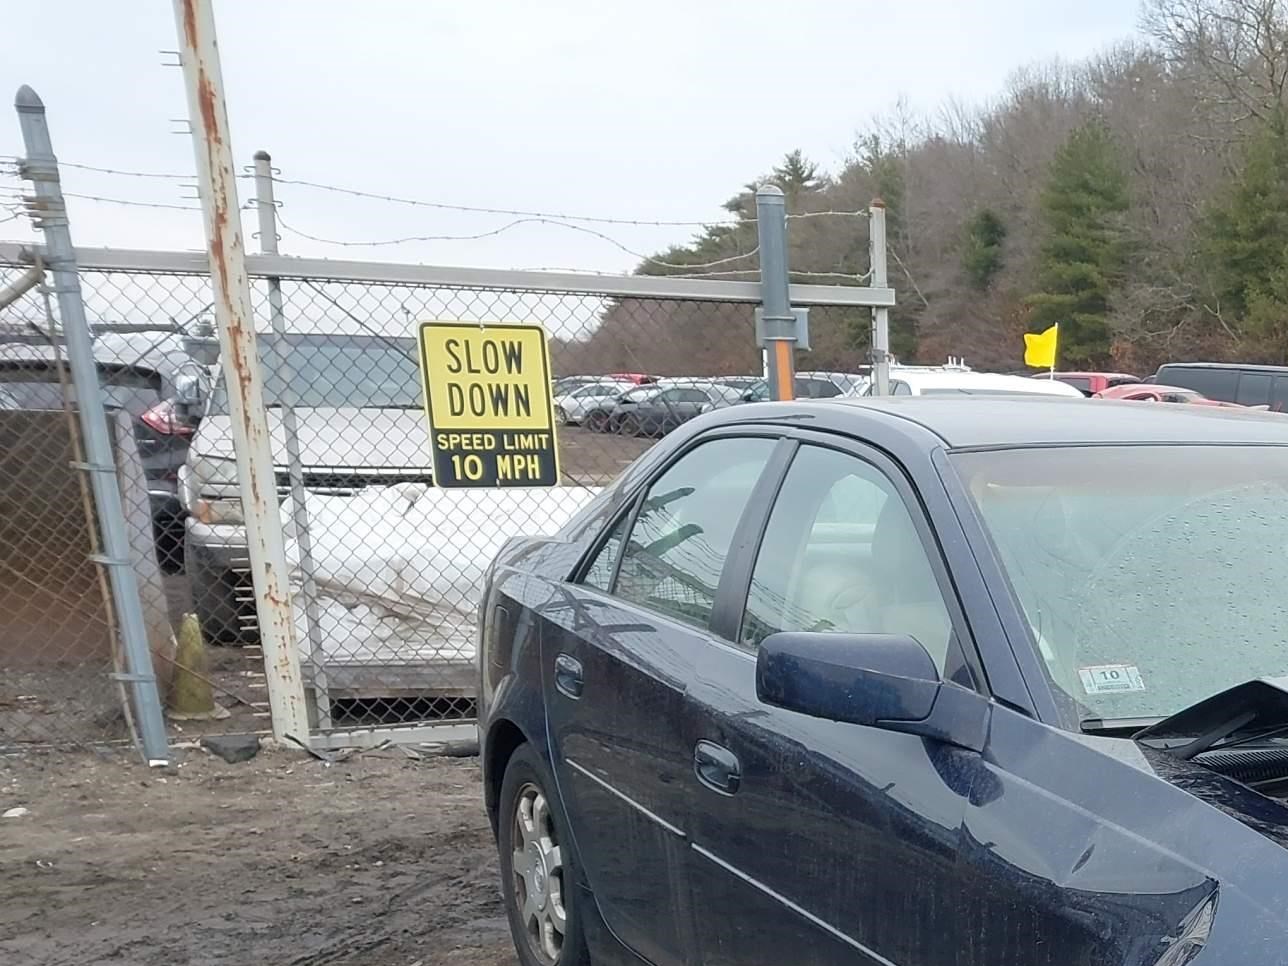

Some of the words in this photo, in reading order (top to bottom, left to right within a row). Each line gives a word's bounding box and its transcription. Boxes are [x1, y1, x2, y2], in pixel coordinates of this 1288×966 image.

[445, 339, 522, 374] SLOW
[447, 382, 531, 417] DOWN
[437, 434, 495, 450] SPEED
[503, 434, 549, 450] LIMIT
[451, 454, 483, 480] 10
[496, 454, 540, 480] MPH
[1100, 670, 1120, 680] 10
